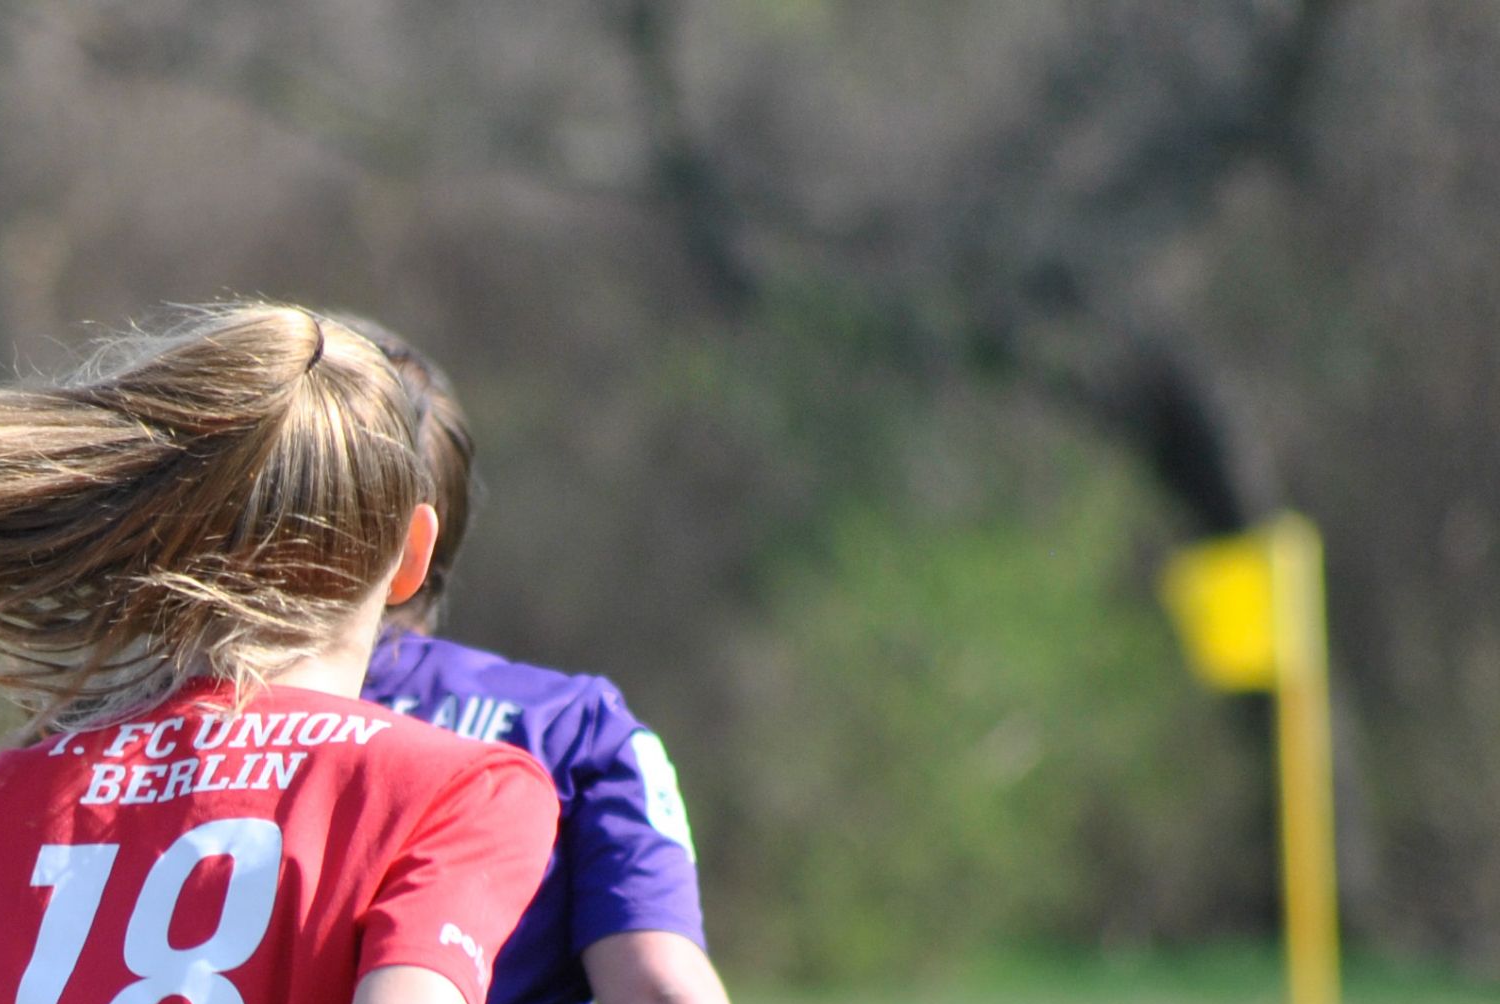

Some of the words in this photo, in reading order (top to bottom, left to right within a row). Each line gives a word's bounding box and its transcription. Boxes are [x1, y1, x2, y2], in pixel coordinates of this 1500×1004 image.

[103, 716, 186, 760] FC
[193, 712, 392, 752] UNION
[79, 752, 308, 805] BERLIN
